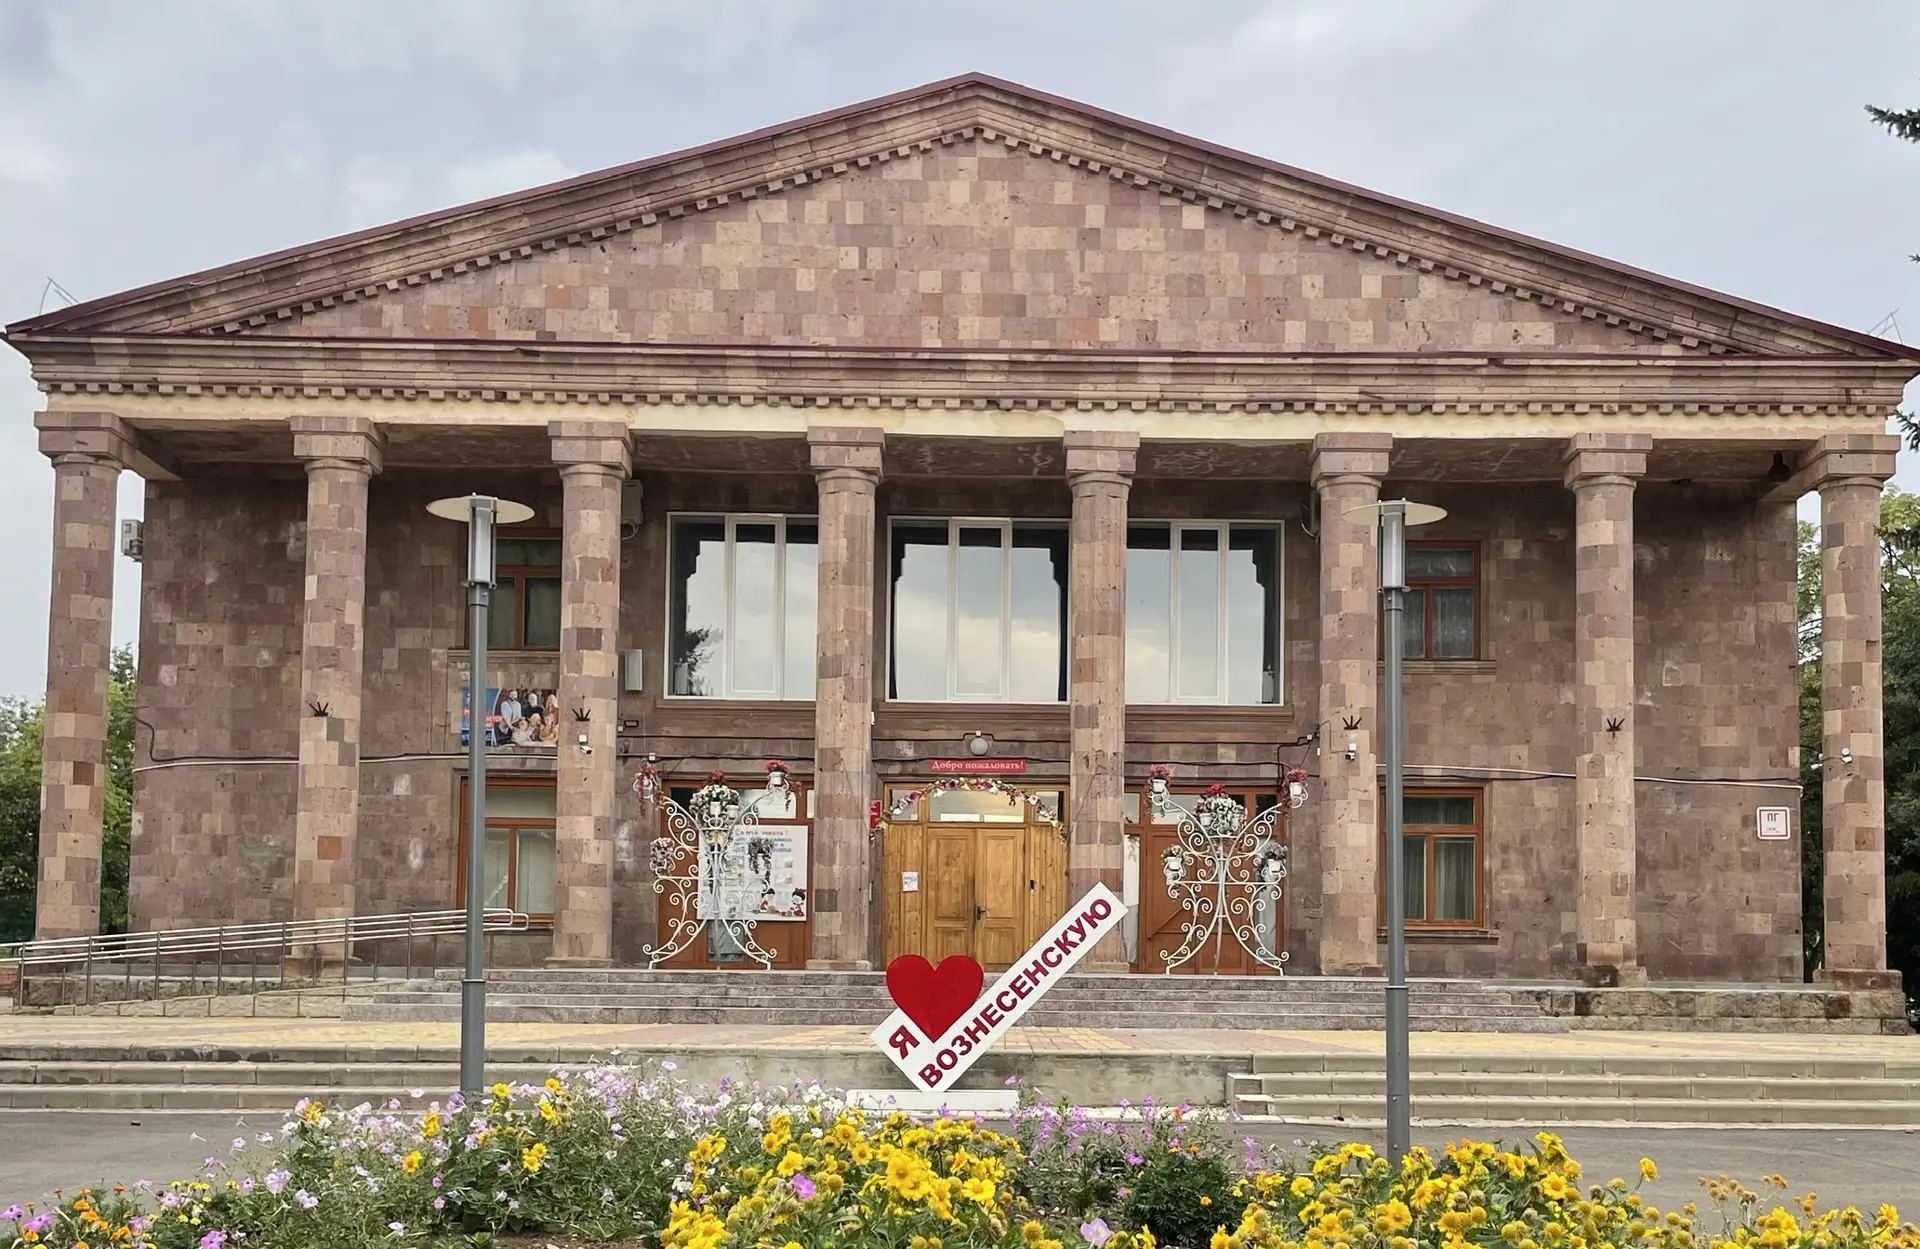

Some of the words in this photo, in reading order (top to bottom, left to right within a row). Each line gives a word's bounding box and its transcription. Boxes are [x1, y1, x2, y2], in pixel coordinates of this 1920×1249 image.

[932, 760, 963, 771] Добро
[965, 760, 1024, 770] пожаловать!
[918, 898, 1112, 1088] ВОЗНЕСЕНСКУЮ
[888, 1024, 920, 1060] Я
